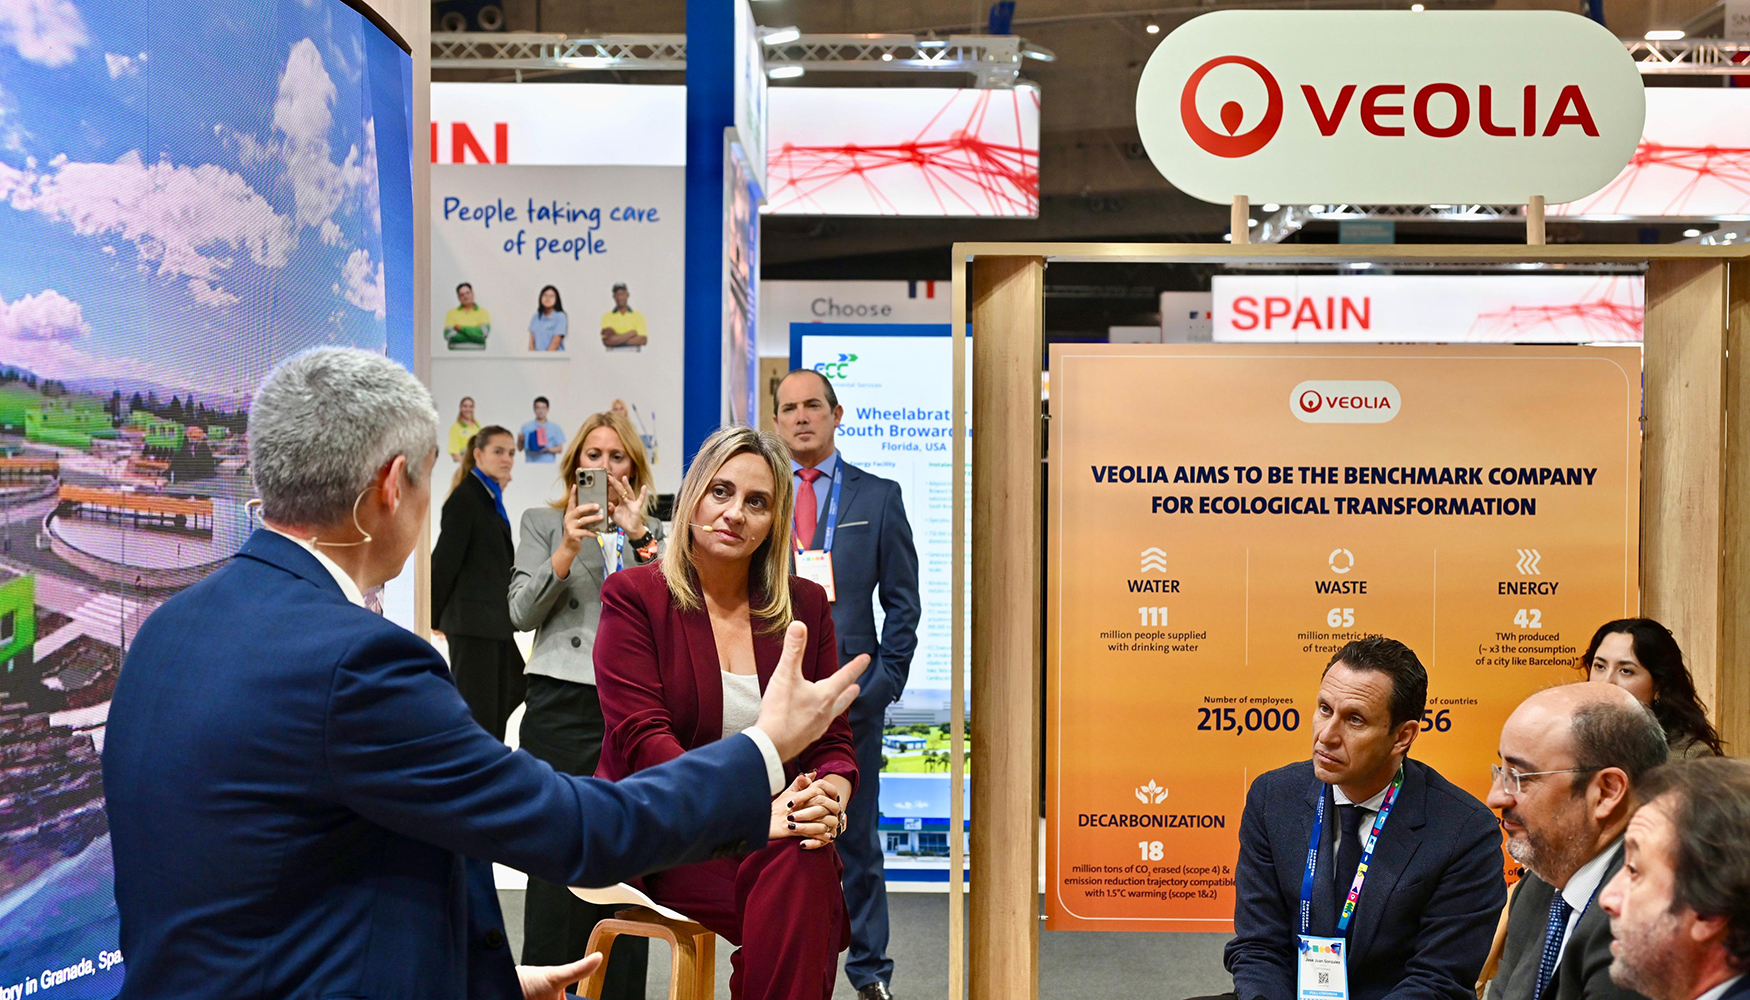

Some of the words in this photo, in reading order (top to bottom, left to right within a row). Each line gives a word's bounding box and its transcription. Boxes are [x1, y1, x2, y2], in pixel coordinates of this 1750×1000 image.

[1300, 82, 1600, 138] VEOLIA
[444, 197, 517, 228] People
[526, 198, 601, 230] taking
[609, 206, 660, 222] care
[503, 230, 526, 255] of
[536, 230, 607, 261] people
[811, 297, 892, 317] Choose
[1231, 296, 1371, 330] SPAIN
[1326, 396, 1391, 409] VEOLIA
[856, 407, 968, 420] Wheelabrat
[837, 424, 884, 437] South
[882, 442, 922, 452] Florida,
[925, 442, 947, 451] USA
[1091, 465, 1169, 483] VEOLIA
[1173, 466, 1230, 484] AIMS
[1234, 466, 1262, 484] TO
[1268, 466, 1293, 484] BE
[1298, 467, 1339, 484] THE
[1344, 467, 1483, 485] BENCHMARK
[1488, 467, 1598, 485] COMPANY
[1152, 496, 1194, 513] FOR
[1199, 496, 1330, 514] ECOLOGICAL
[1334, 497, 1536, 515] TRANSFORMATION
[1127, 580, 1180, 593] WATER
[1315, 581, 1367, 594] WASTE
[1498, 582, 1559, 595] ENERGY
[1138, 606, 1168, 626] 111
[1327, 607, 1355, 628] 65
[1513, 608, 1542, 628] 42
[1100, 630, 1132, 639] million
[1134, 631, 1165, 641] people
[1168, 631, 1206, 641] supplied
[1297, 631, 1329, 640] million
[1332, 632, 1361, 640] metric
[1496, 632, 1516, 641] TWh
[1519, 632, 1560, 643] produced
[1108, 643, 1129, 651] with
[1131, 643, 1169, 654] drinking
[1303, 644, 1313, 652] of
[1478, 644, 1487, 654] (~
[1490, 645, 1499, 653] x3
[1502, 645, 1516, 653] the
[1518, 645, 1576, 655] consumption
[1475, 657, 1485, 665] of
[1493, 657, 1509, 667] city
[1512, 657, 1527, 665] like
[1204, 696, 1239, 704] Number
[1239, 696, 1248, 704] of
[1249, 696, 1293, 706] employees
[1440, 697, 1478, 705] countries
[1197, 707, 1300, 735] 215,000
[1078, 814, 1225, 828] DECARBONIZATION
[1138, 841, 1164, 861] 18
[1072, 865, 1102, 873] million
[1124, 865, 1134, 873] of
[1152, 865, 1181, 874] erased
[1183, 866, 1210, 876] (scope
[1211, 866, 1220, 875] 4)
[1222, 866, 1230, 874] &
[1064, 877, 1102, 885] emission
[1104, 877, 1146, 885] reduction
[1147, 878, 1188, 888] trajectory
[1085, 889, 1104, 897] with
[1106, 889, 1127, 897] 1.5°C
[1128, 889, 1167, 900] warming
[1169, 889, 1196, 899] (scope
[1198, 889, 1217, 899] 1&2)
[25, 976, 37, 996] in
[40, 957, 95, 990] Granada,
[98, 949, 123, 971] Spa
